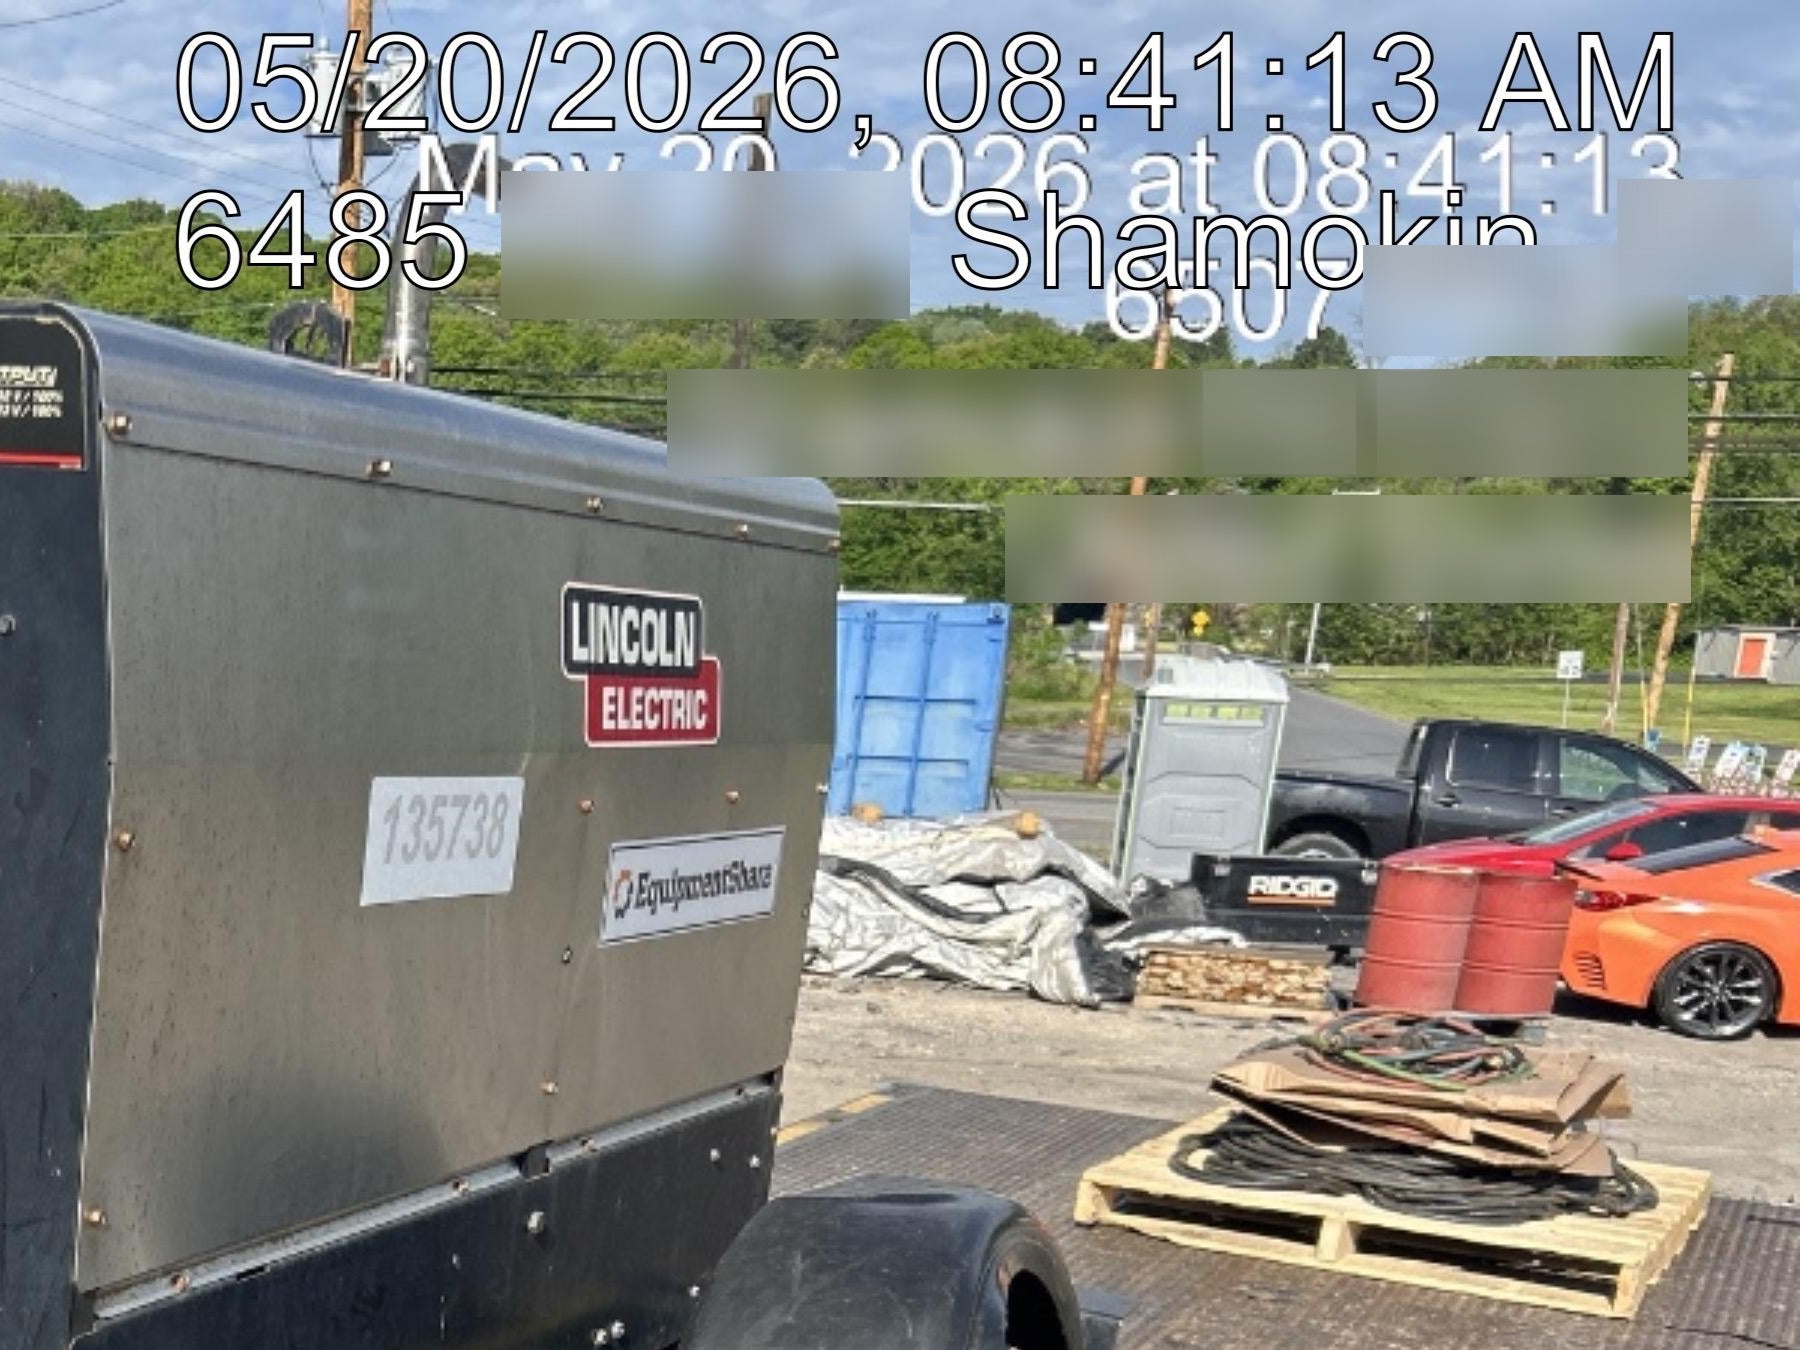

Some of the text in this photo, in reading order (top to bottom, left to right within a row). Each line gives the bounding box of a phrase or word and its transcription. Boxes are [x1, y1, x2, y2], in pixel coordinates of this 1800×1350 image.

[571, 600, 695, 668] LINCOLN
[602, 685, 708, 731] ELECTRIC
[383, 792, 508, 865] 135738
[634, 860, 773, 916] EquipmentShare
[1247, 874, 1339, 898] RIDGID
